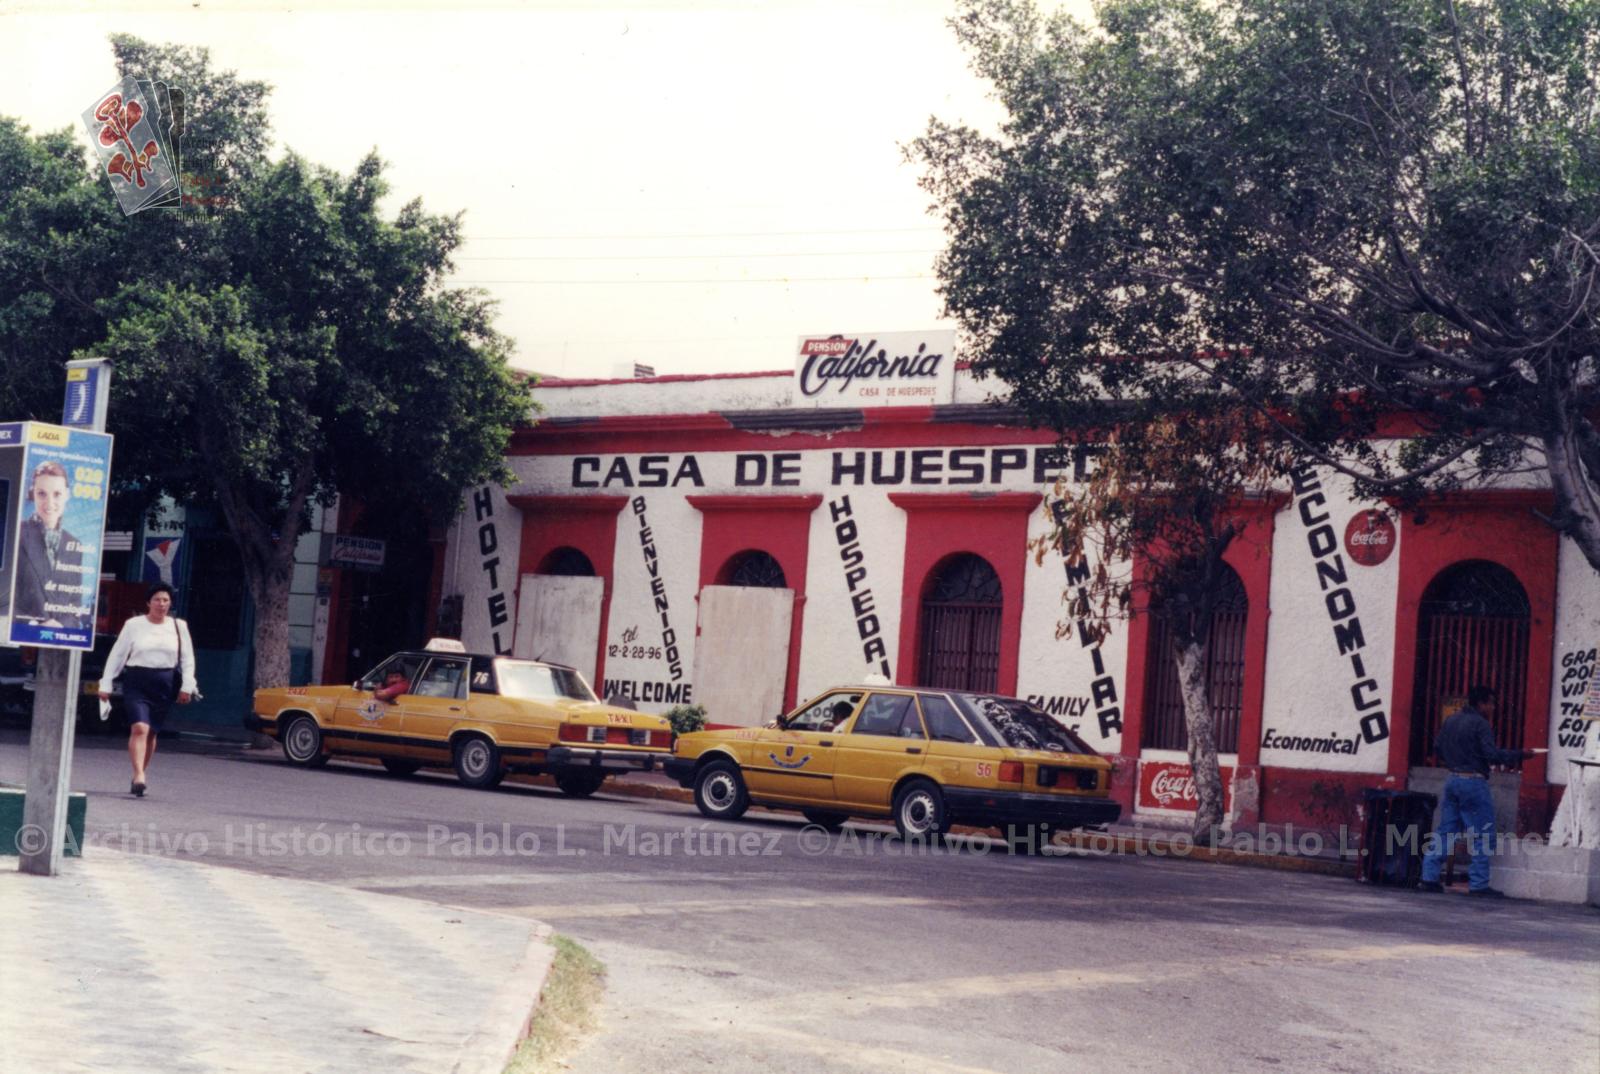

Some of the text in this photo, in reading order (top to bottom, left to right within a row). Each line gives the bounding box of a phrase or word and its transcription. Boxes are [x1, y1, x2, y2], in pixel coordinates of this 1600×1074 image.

[807, 340, 847, 352] PENSION
[800, 335, 943, 396] California
[859, 387, 879, 397] CASA
[37, 431, 60, 441] LADA
[572, 455, 705, 488] CASA
[734, 453, 802, 487] DE
[473, 486, 512, 655] HOTEL
[631, 495, 683, 681] BIENVENIDOS
[1290, 466, 1390, 745] ECONOMICO
[55, 632, 88, 642] TELMEX
[621, 625, 639, 643] tel
[473, 671, 489, 685] 76
[603, 679, 693, 704] WELCOME
[608, 713, 633, 725] TAXI
[1261, 728, 1362, 755] Economical
[976, 762, 992, 777] 56
